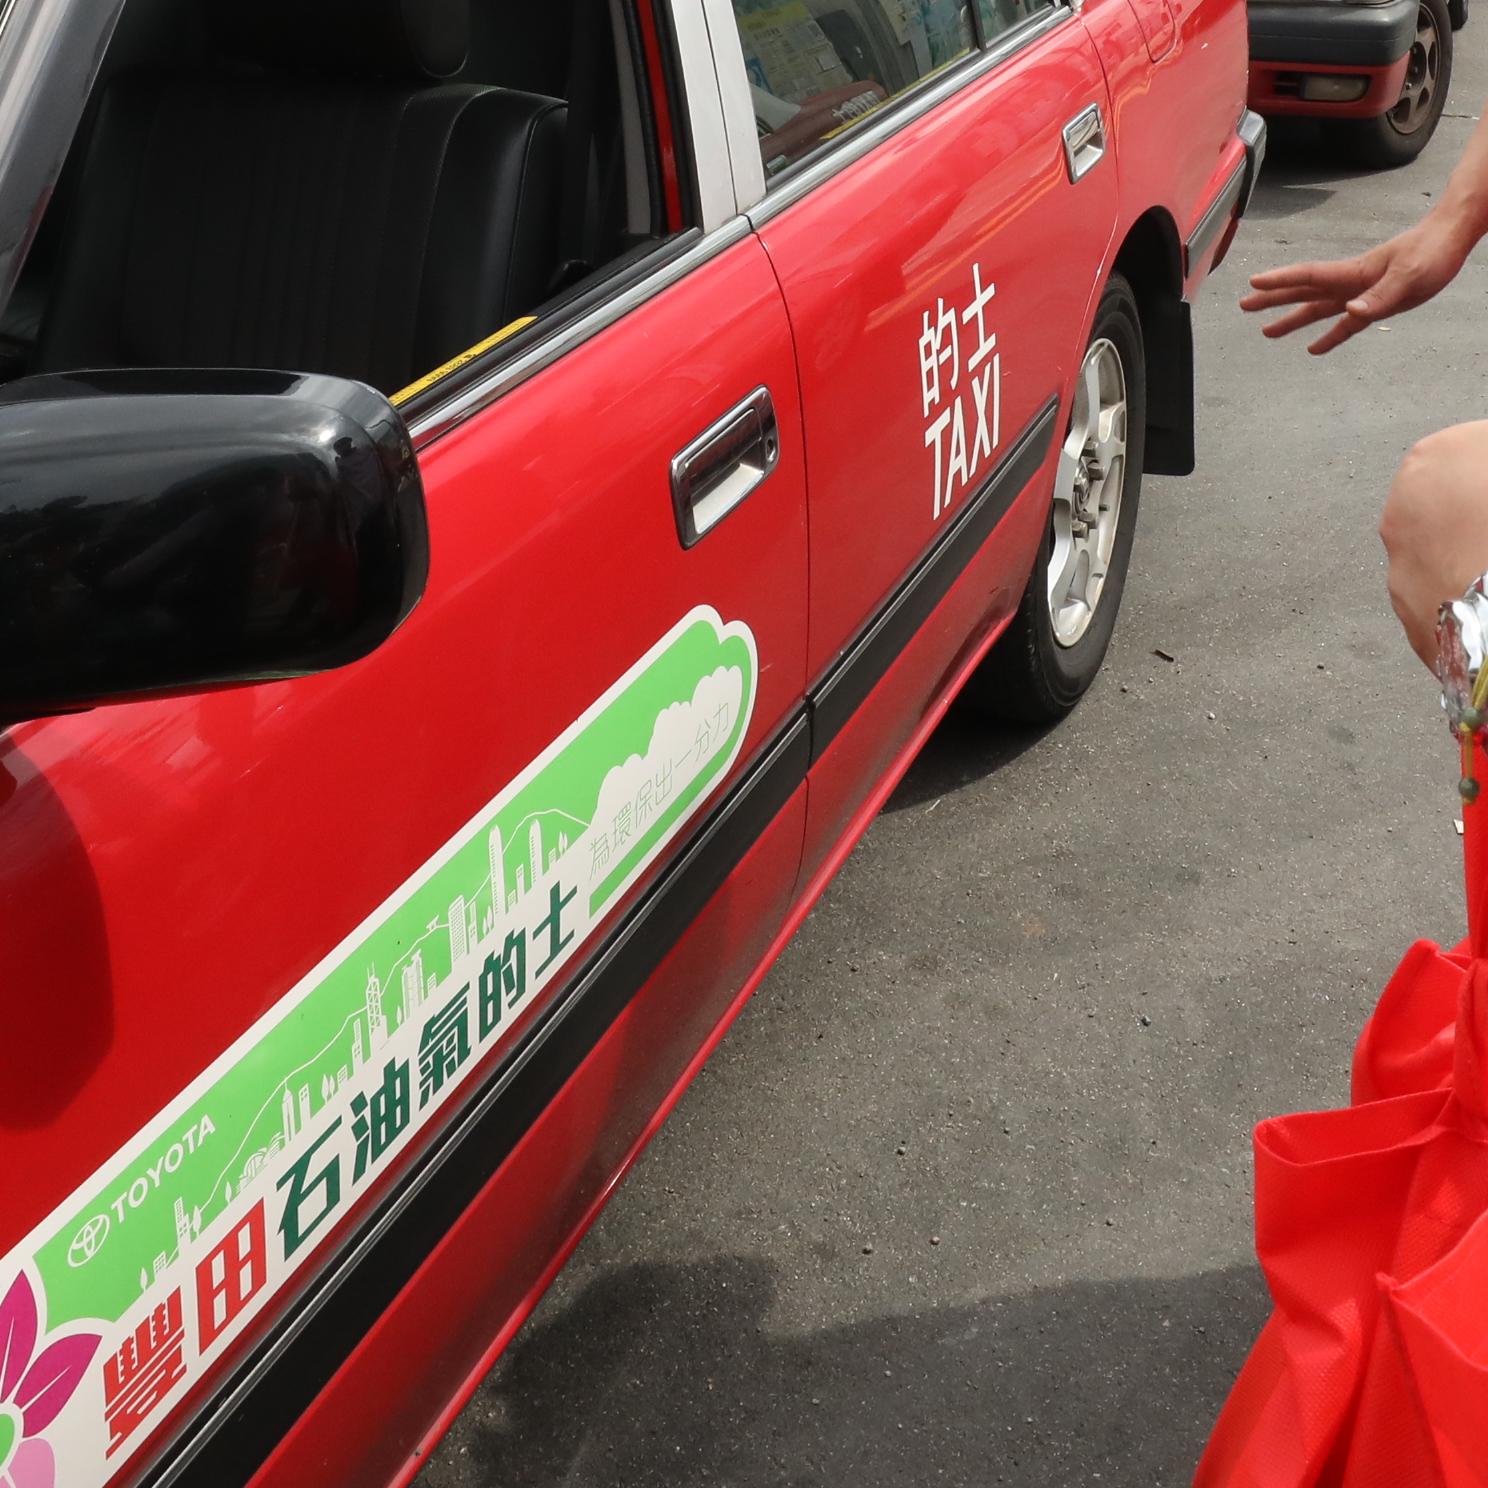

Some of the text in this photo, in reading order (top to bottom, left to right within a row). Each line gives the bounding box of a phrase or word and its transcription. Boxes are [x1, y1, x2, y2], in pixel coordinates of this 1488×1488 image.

[918, 262, 997, 419] 的士
[924, 352, 1001, 521] TAXI
[589, 701, 730, 881] 為環保出一分力
[110, 1113, 216, 1224] TOYOTA
